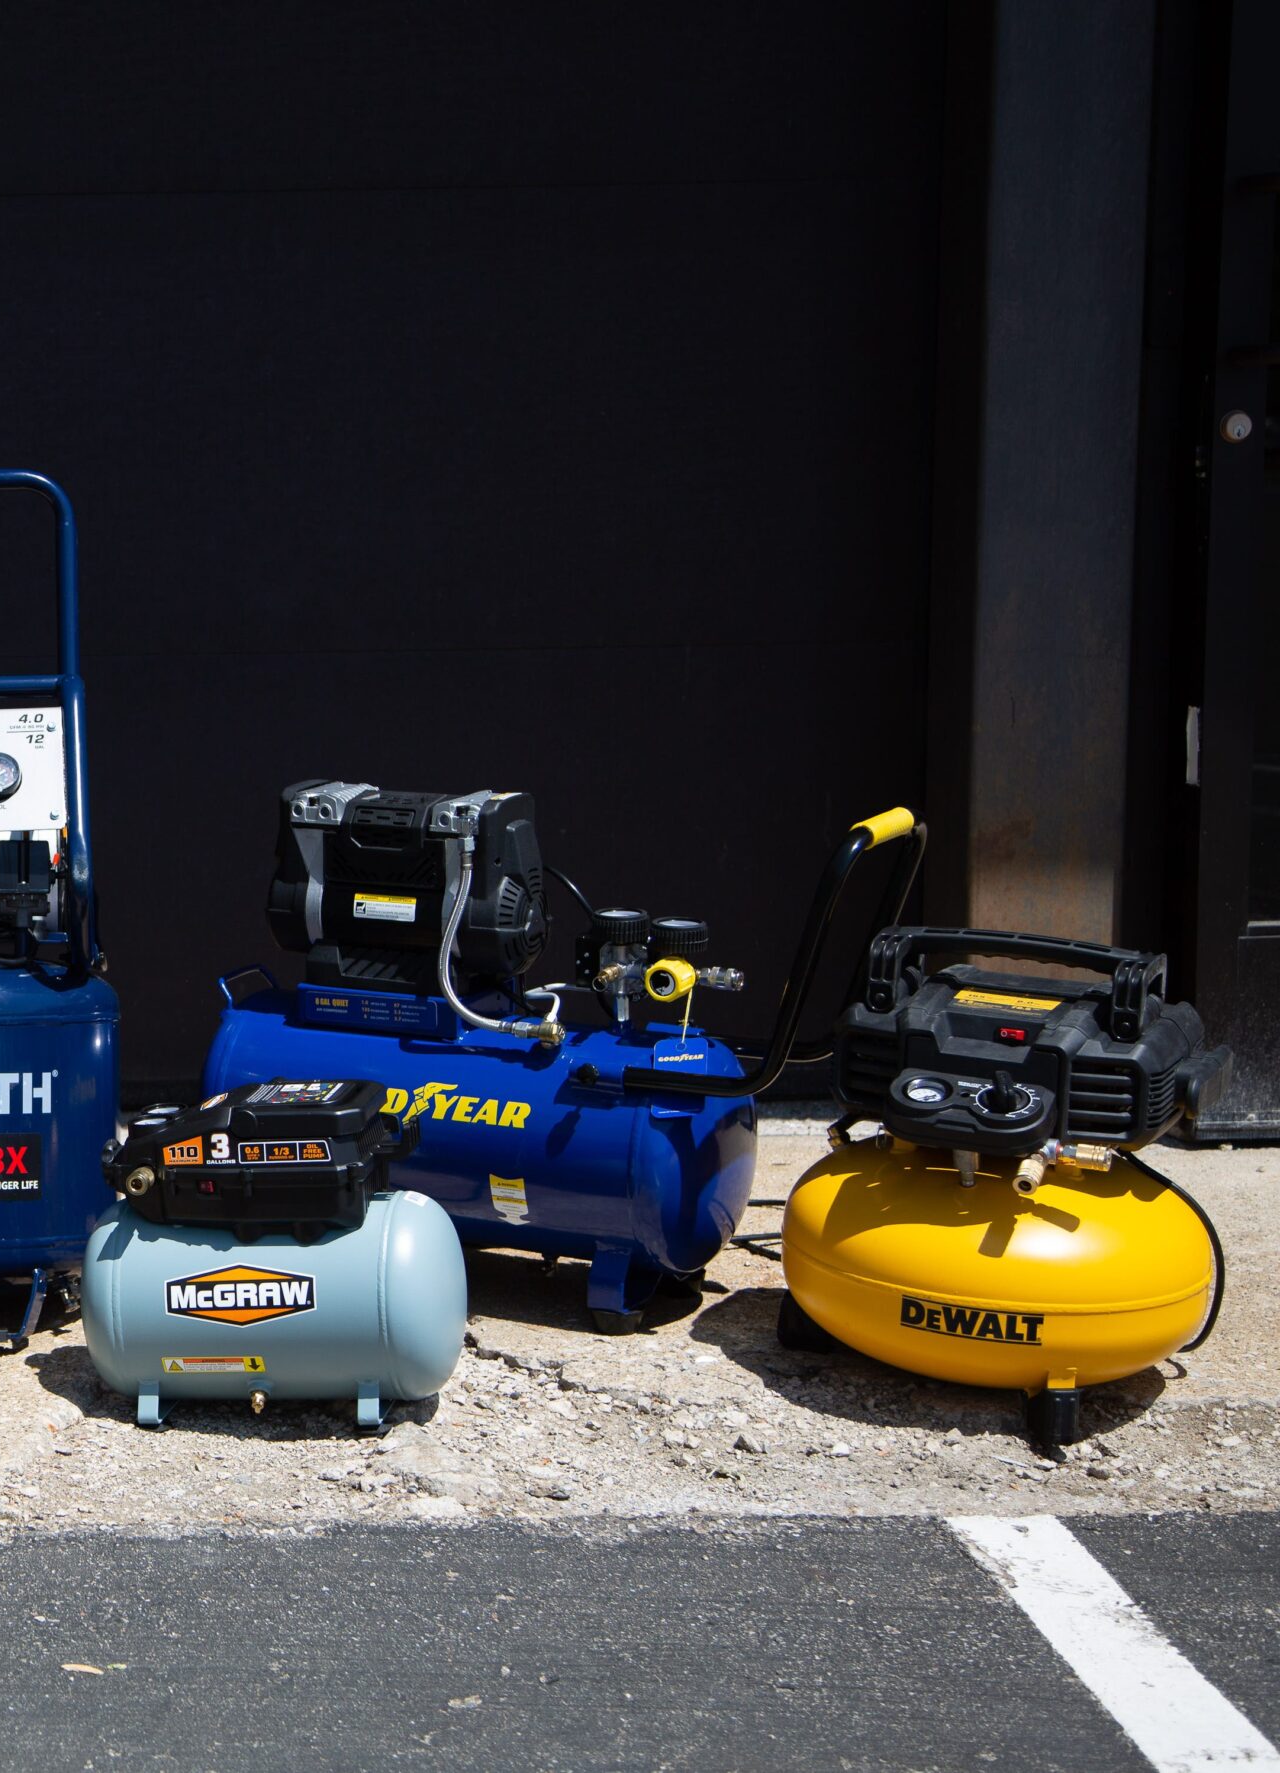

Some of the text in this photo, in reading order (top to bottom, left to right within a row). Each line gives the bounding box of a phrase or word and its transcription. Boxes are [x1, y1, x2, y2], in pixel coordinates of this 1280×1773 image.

[18, 713, 44, 724] 4.0
[25, 734, 45, 744] 12
[331, 998, 349, 1008] QUIET
[657, 1053, 705, 1063] GOODYEAR
[210, 1133, 230, 1159] 3
[245, 1146, 260, 1154] 0.6
[168, 1146, 199, 1158] 110
[273, 1147, 290, 1156] 1/3
[21, 1179, 39, 1190] LIFE
[170, 1281, 310, 1309] McGRAW
